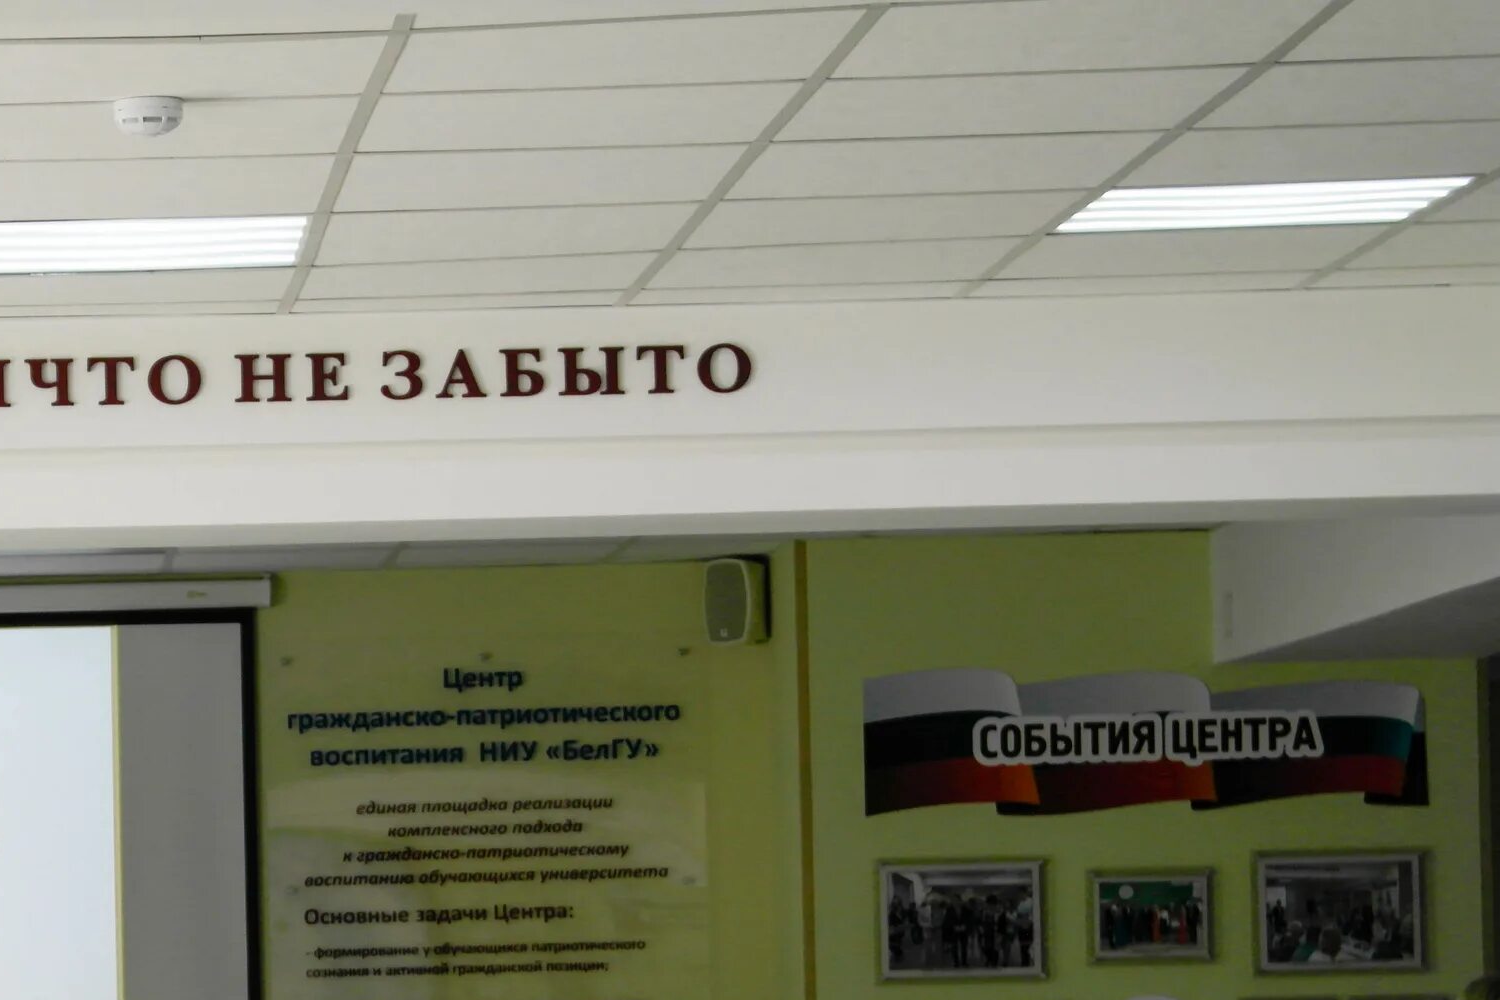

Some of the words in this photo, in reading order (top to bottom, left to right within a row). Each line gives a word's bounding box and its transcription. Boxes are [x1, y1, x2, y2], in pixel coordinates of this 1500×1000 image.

[235, 352, 350, 404] НЕ
[380, 342, 753, 401] ЗАБЫТО
[443, 668, 523, 692] Центр
[287, 705, 680, 733] гражданско-патриотического
[979, 719, 1157, 759] СОБЫТИЯ
[1171, 716, 1318, 761] ЦЕНТРА
[310, 747, 463, 766] воспитания
[480, 741, 537, 762] НИУ
[546, 738, 659, 760] «БелГУ»
[356, 799, 417, 815] единая
[421, 797, 507, 814] площадка
[512, 798, 614, 813] реализации
[388, 823, 507, 837] комплексного
[512, 818, 584, 834] подхода
[356, 844, 630, 863] гражданско-патриотическому
[304, 874, 414, 887] воспитанию
[418, 868, 535, 885] обучающихся
[540, 866, 669, 883] университета
[304, 908, 409, 925] Основные
[416, 907, 487, 925] задачи
[494, 904, 575, 923] Центра:
